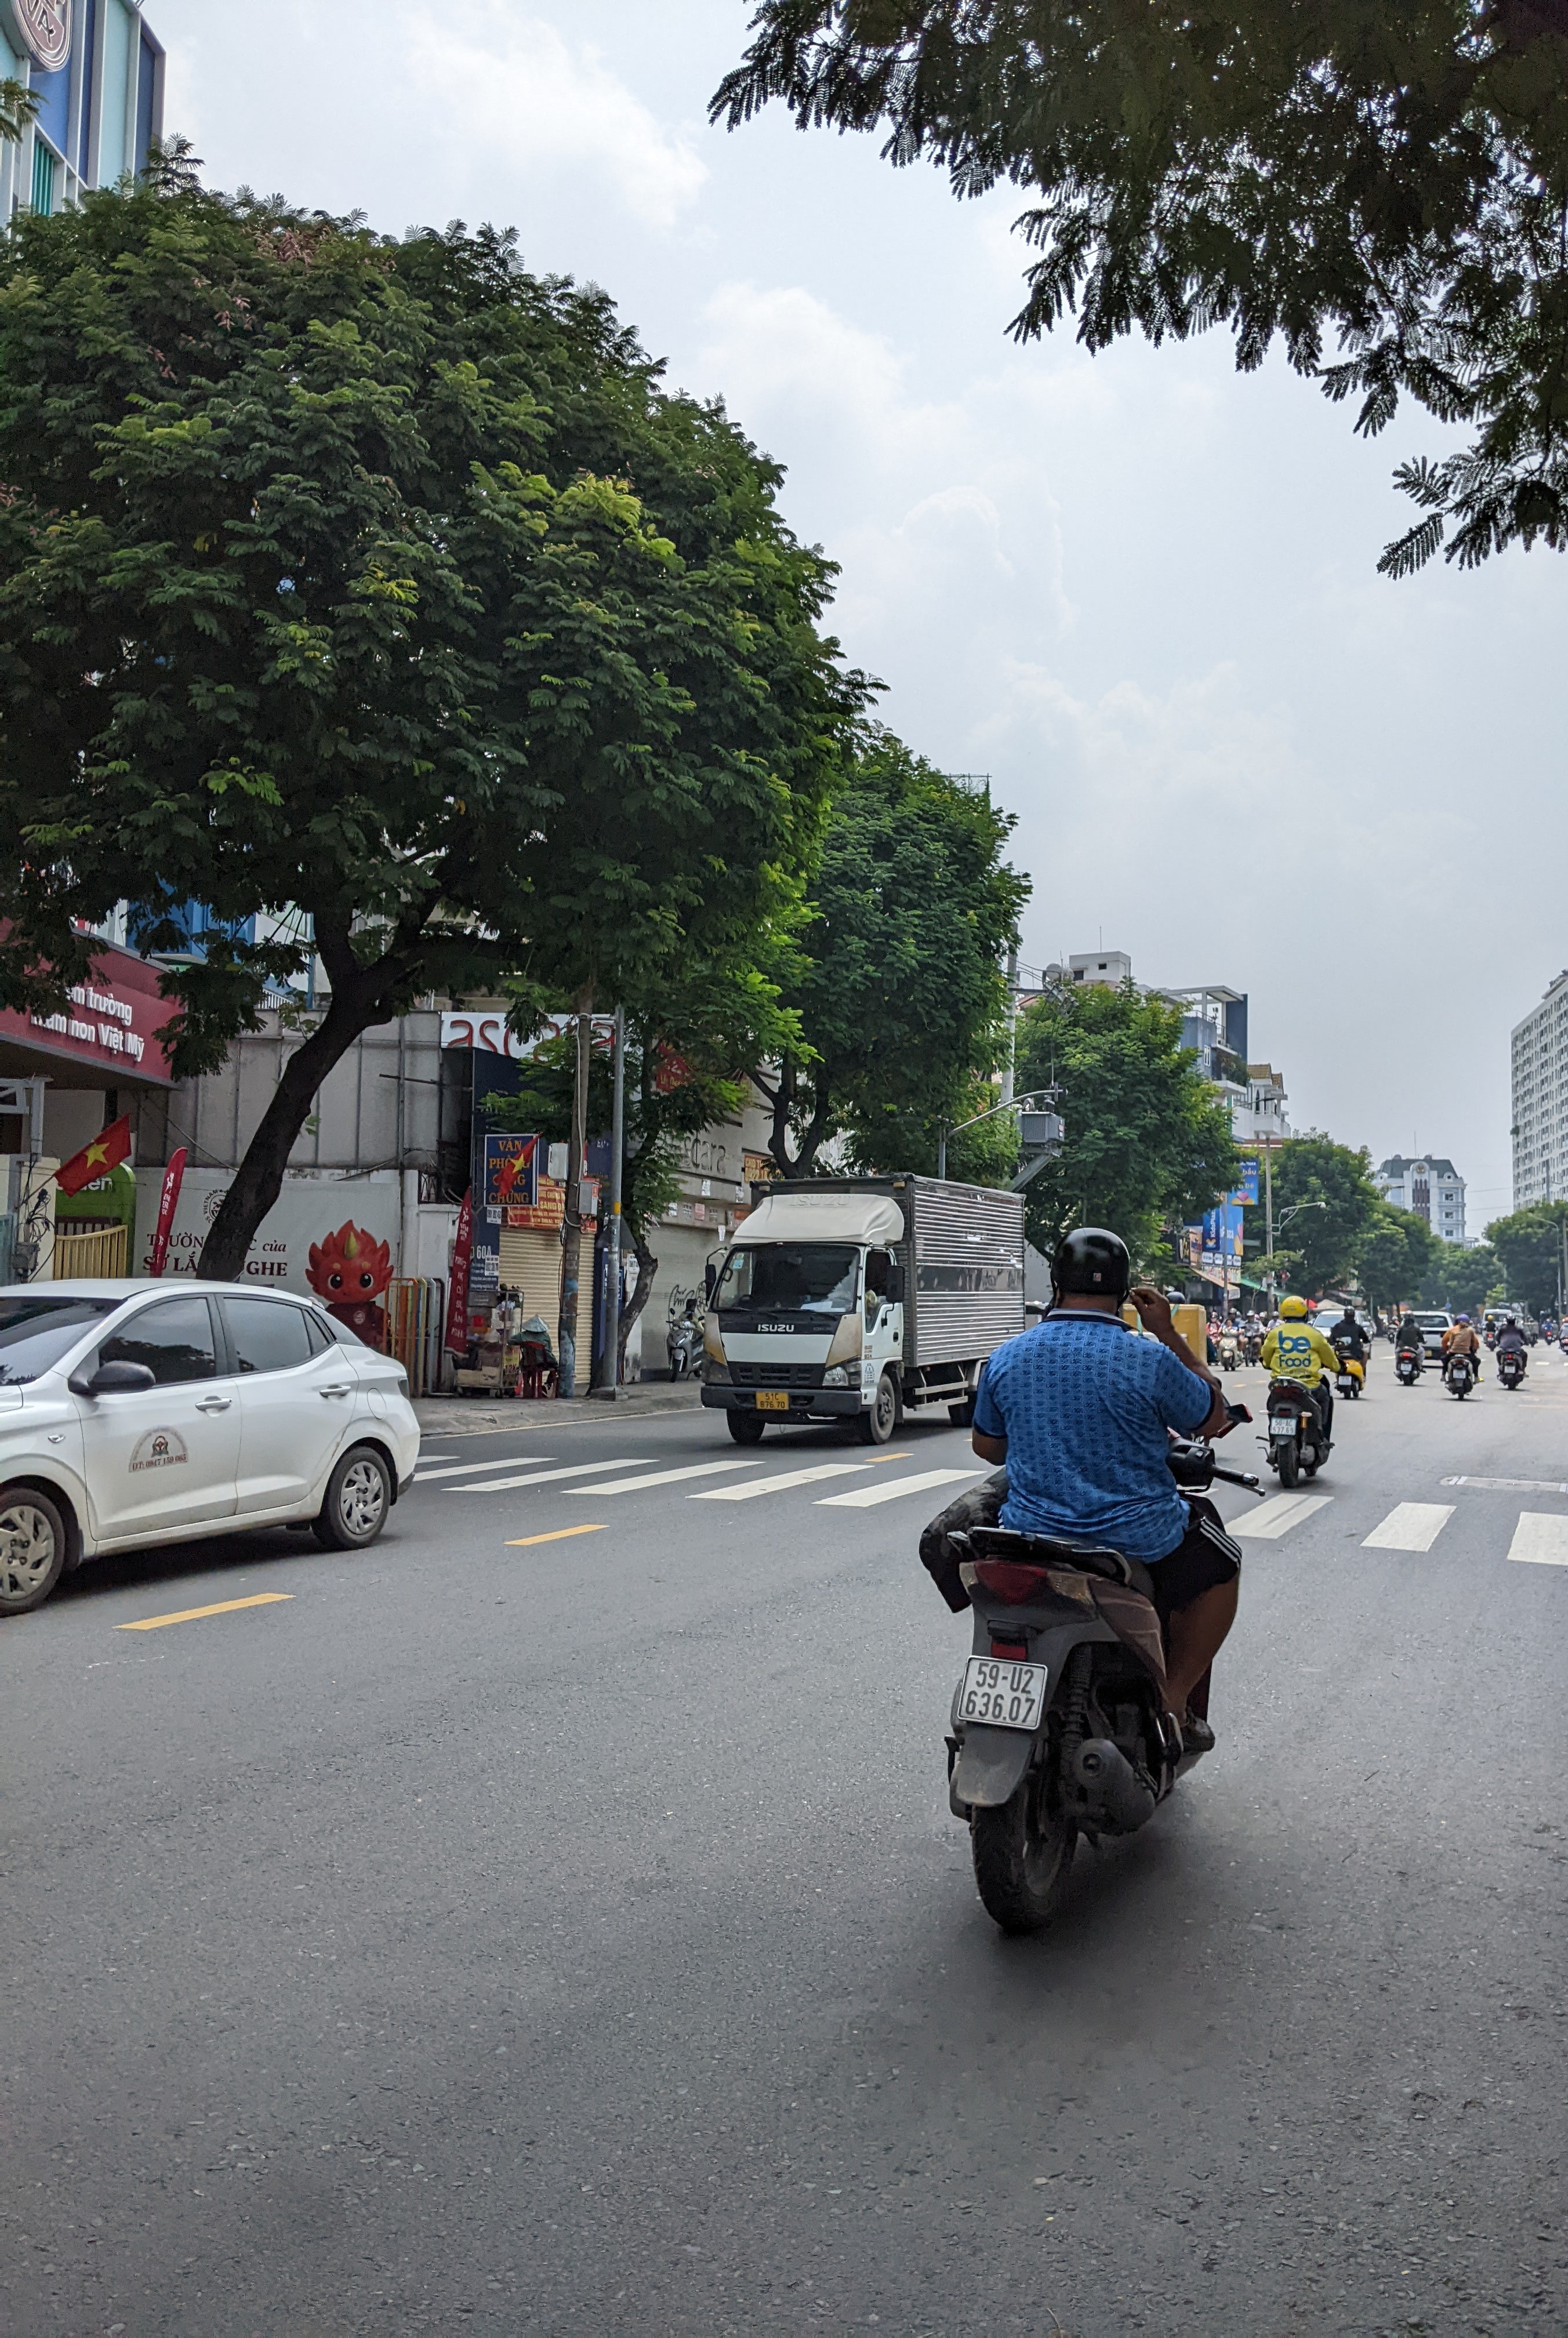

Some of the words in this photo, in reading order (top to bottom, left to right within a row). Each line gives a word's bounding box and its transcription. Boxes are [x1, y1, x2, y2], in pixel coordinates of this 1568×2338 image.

[86, 988, 132, 1026] trường
[68, 1019, 95, 1043] non
[97, 1023, 124, 1054] Việt
[125, 1032, 144, 1062] Mỹ
[498, 1138, 522, 1151] VĂN
[789, 1196, 855, 1206] ISUZU
[147, 1232, 205, 1248] TƯỜN
[262, 1240, 286, 1252] của
[243, 1261, 288, 1276] GHE
[1278, 1331, 1311, 1354] be
[1279, 1354, 1311, 1368] Food
[976, 1662, 1034, 1694] 59-U2
[966, 1690, 1036, 1723] 636.07
